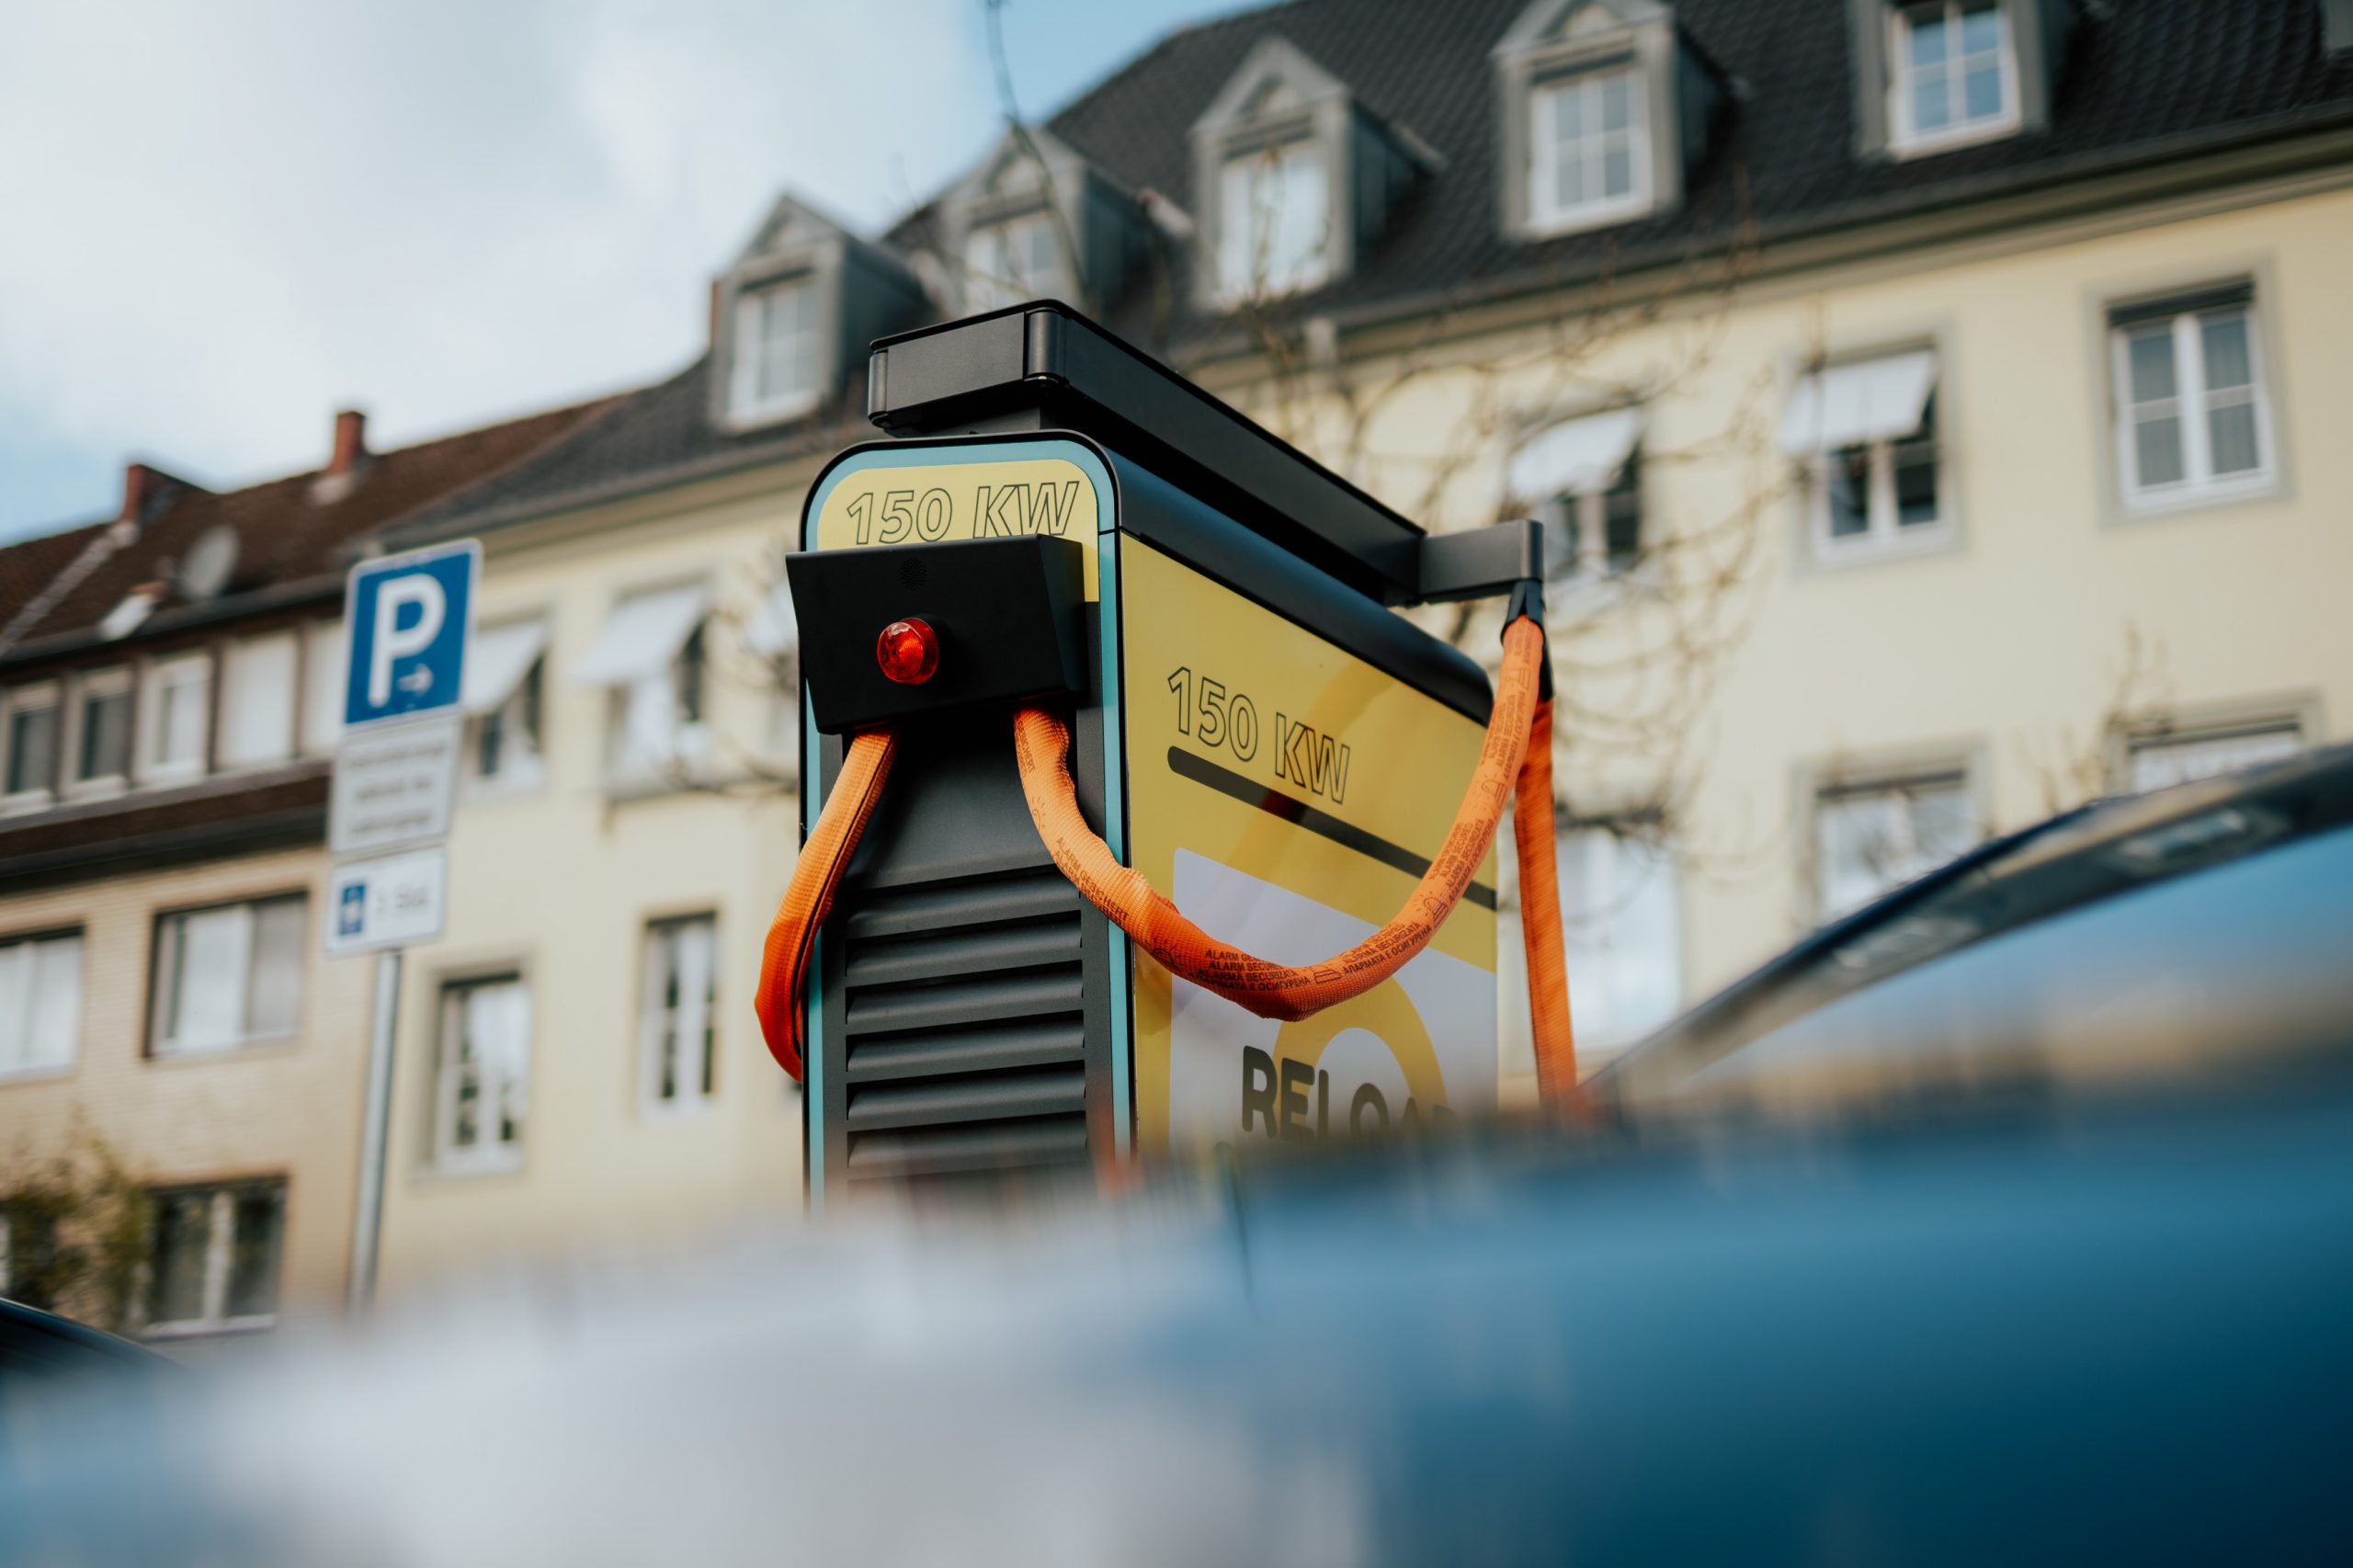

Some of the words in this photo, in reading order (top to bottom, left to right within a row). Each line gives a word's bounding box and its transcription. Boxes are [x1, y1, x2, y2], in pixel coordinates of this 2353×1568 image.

[846, 487, 953, 545] 150
[972, 481, 1081, 539] KW
[367, 573, 448, 709] P
[1166, 665, 1259, 763] 150
[1274, 711, 1351, 805] KW
[1205, 949, 1239, 960] ALARM
[1209, 960, 1245, 971] ALARM
[1246, 961, 1284, 971] SECUR
[1241, 1045, 1460, 1142] RELO
